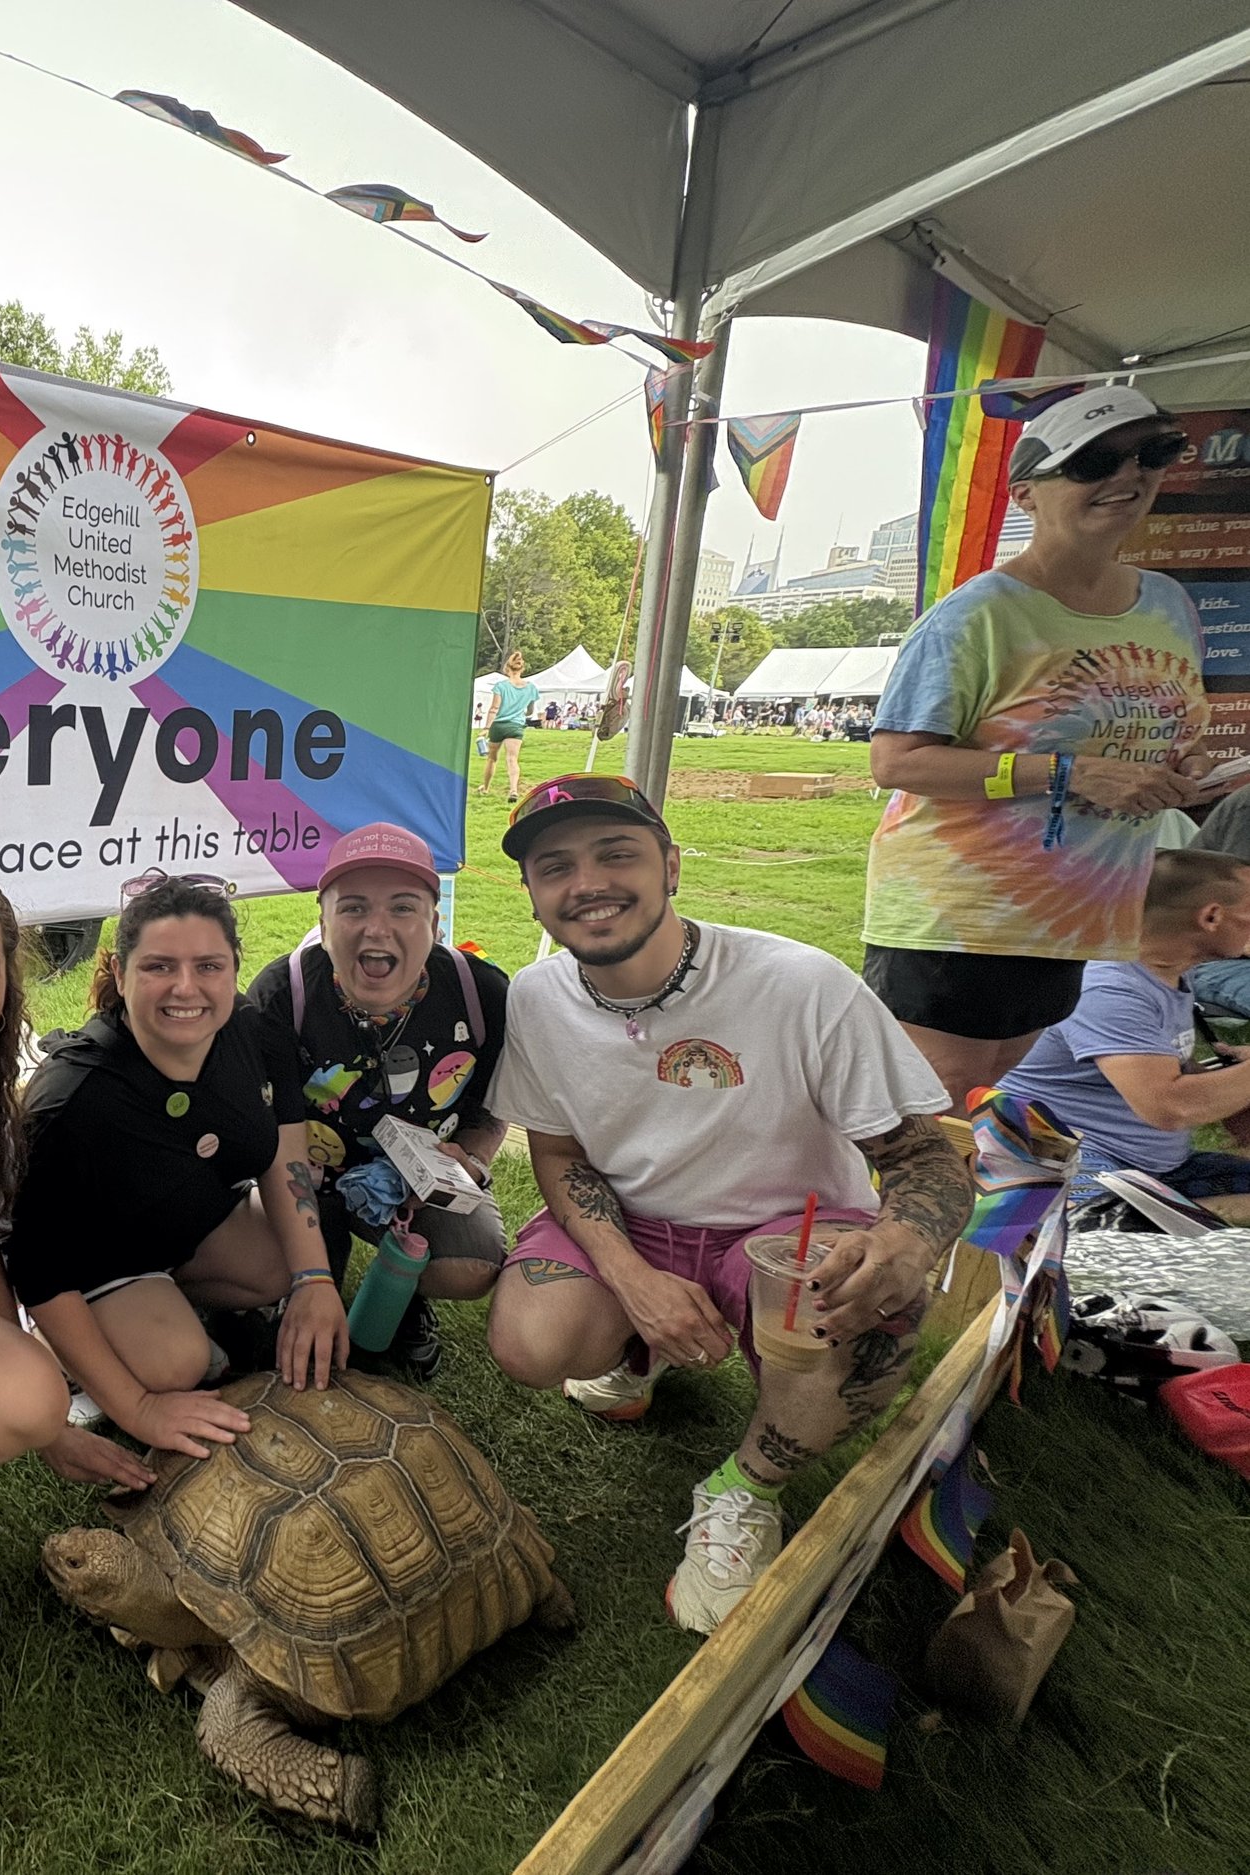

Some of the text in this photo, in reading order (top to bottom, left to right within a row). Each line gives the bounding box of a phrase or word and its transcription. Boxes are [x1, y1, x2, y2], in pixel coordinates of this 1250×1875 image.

[62, 495, 141, 528] Edgehill
[1176, 520, 1220, 533] value
[68, 526, 132, 555] United
[1150, 549, 1175, 561] the
[1179, 548, 1213, 560] way
[1216, 546, 1244, 559] you
[54, 553, 147, 585] Methodist
[67, 584, 135, 611] Church
[1096, 680, 1187, 701] Edgehill
[1113, 700, 1188, 719] United
[1091, 719, 1201, 741] Methodist
[100, 826, 141, 867] at
[154, 816, 219, 862] this
[232, 810, 321, 854] table
[363, 833, 379, 841] not
[359, 843, 379, 853] sad
